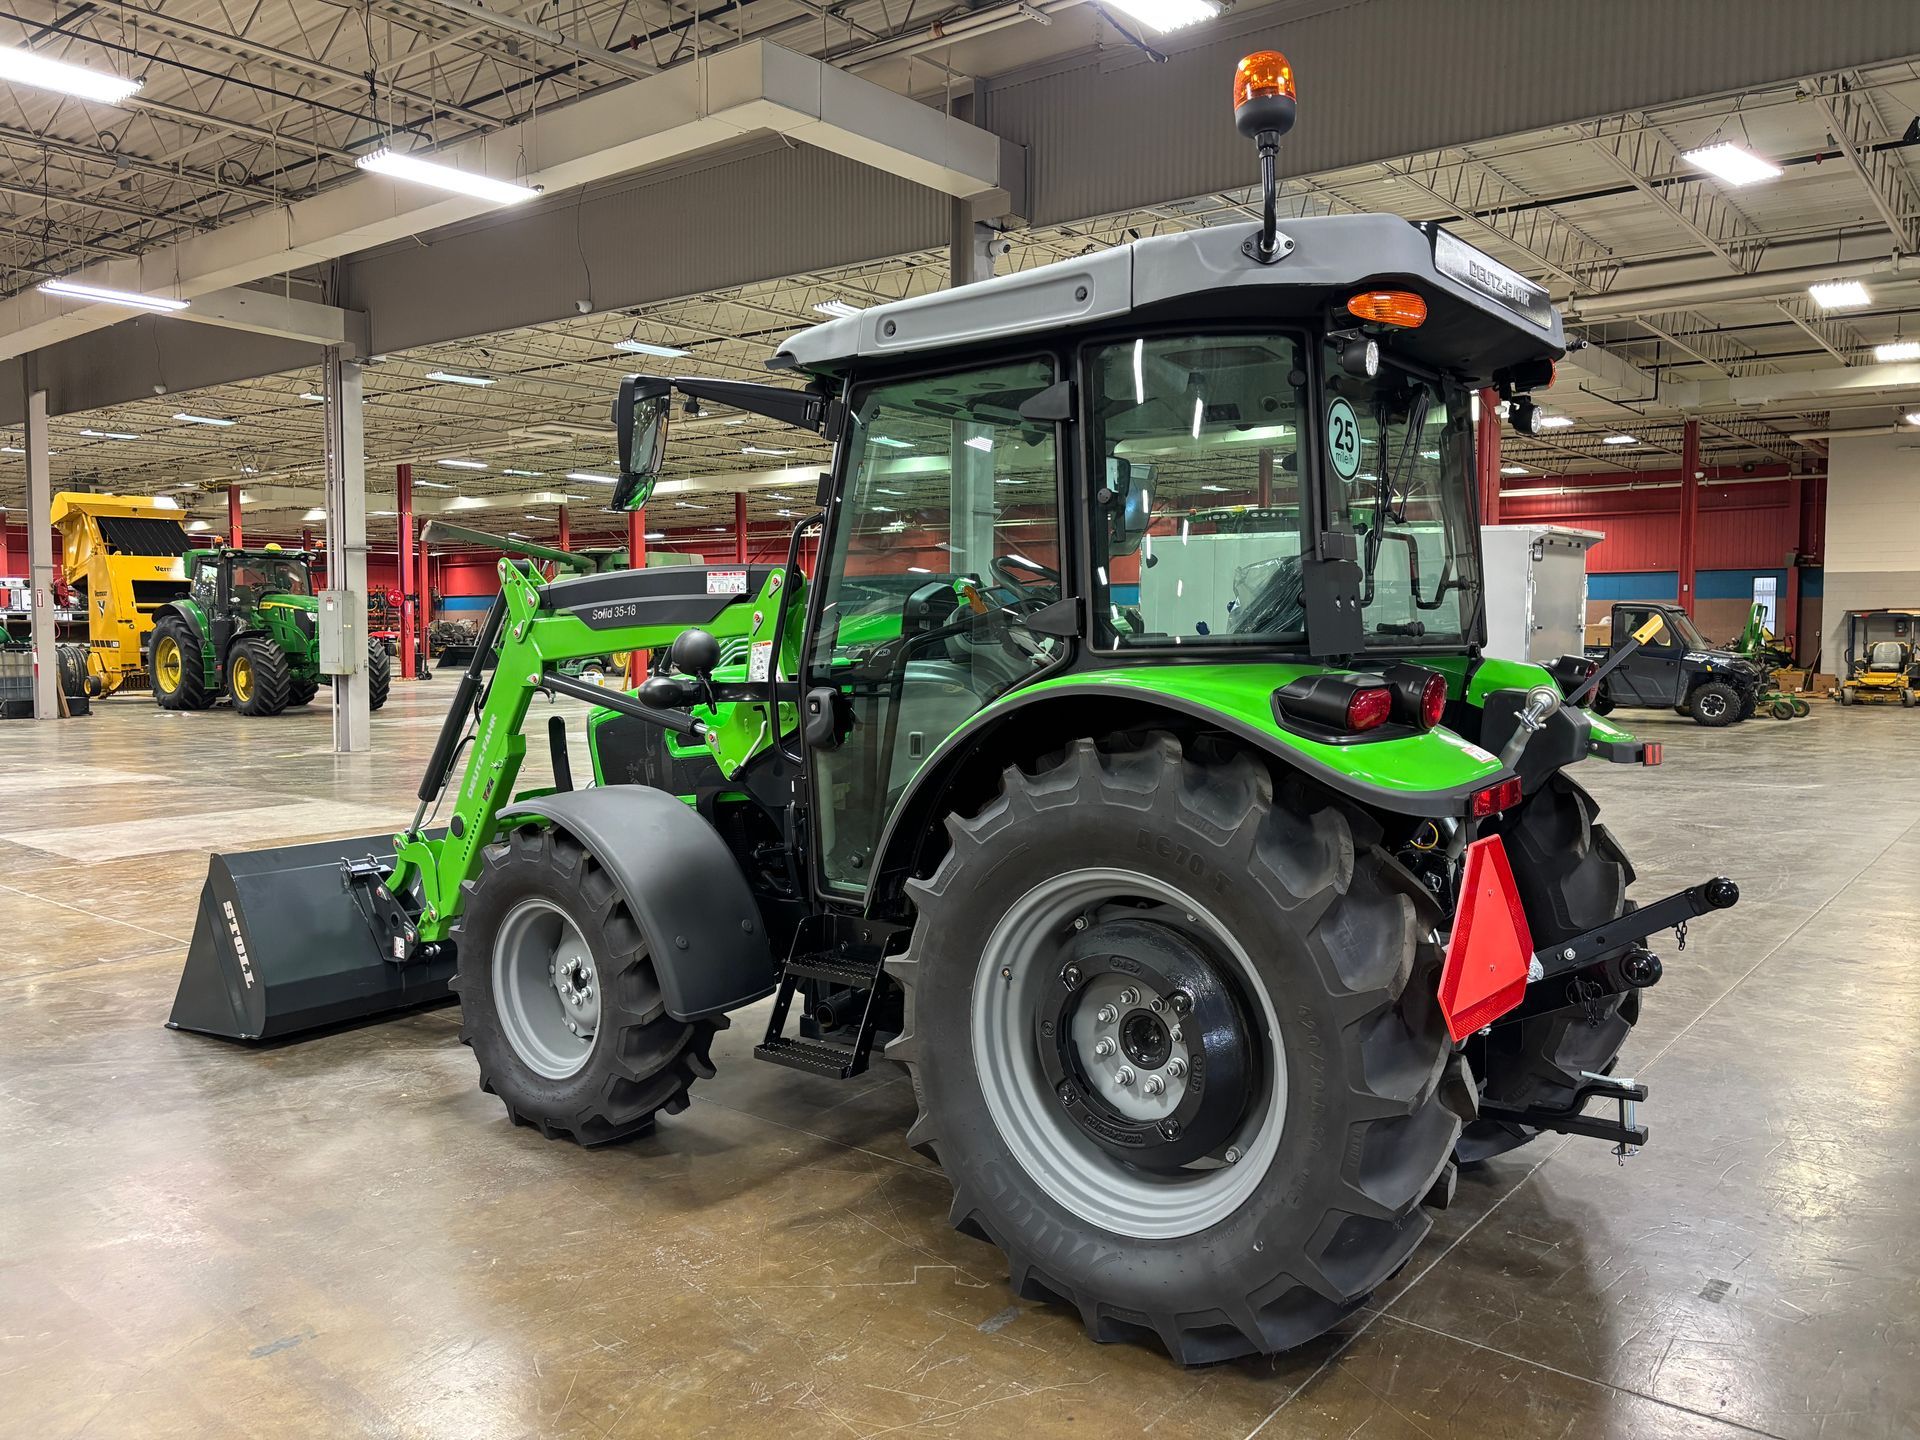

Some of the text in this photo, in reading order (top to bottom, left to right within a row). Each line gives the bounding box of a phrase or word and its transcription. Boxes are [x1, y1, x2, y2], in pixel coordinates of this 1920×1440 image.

[1469, 260, 1530, 307] DEUTZ-FAHR
[1334, 416, 1354, 453] 25
[592, 604, 636, 620] Solid 35-18
[467, 713, 497, 799] DEUTZ-FAHR
[222, 900, 255, 989] STOLL
